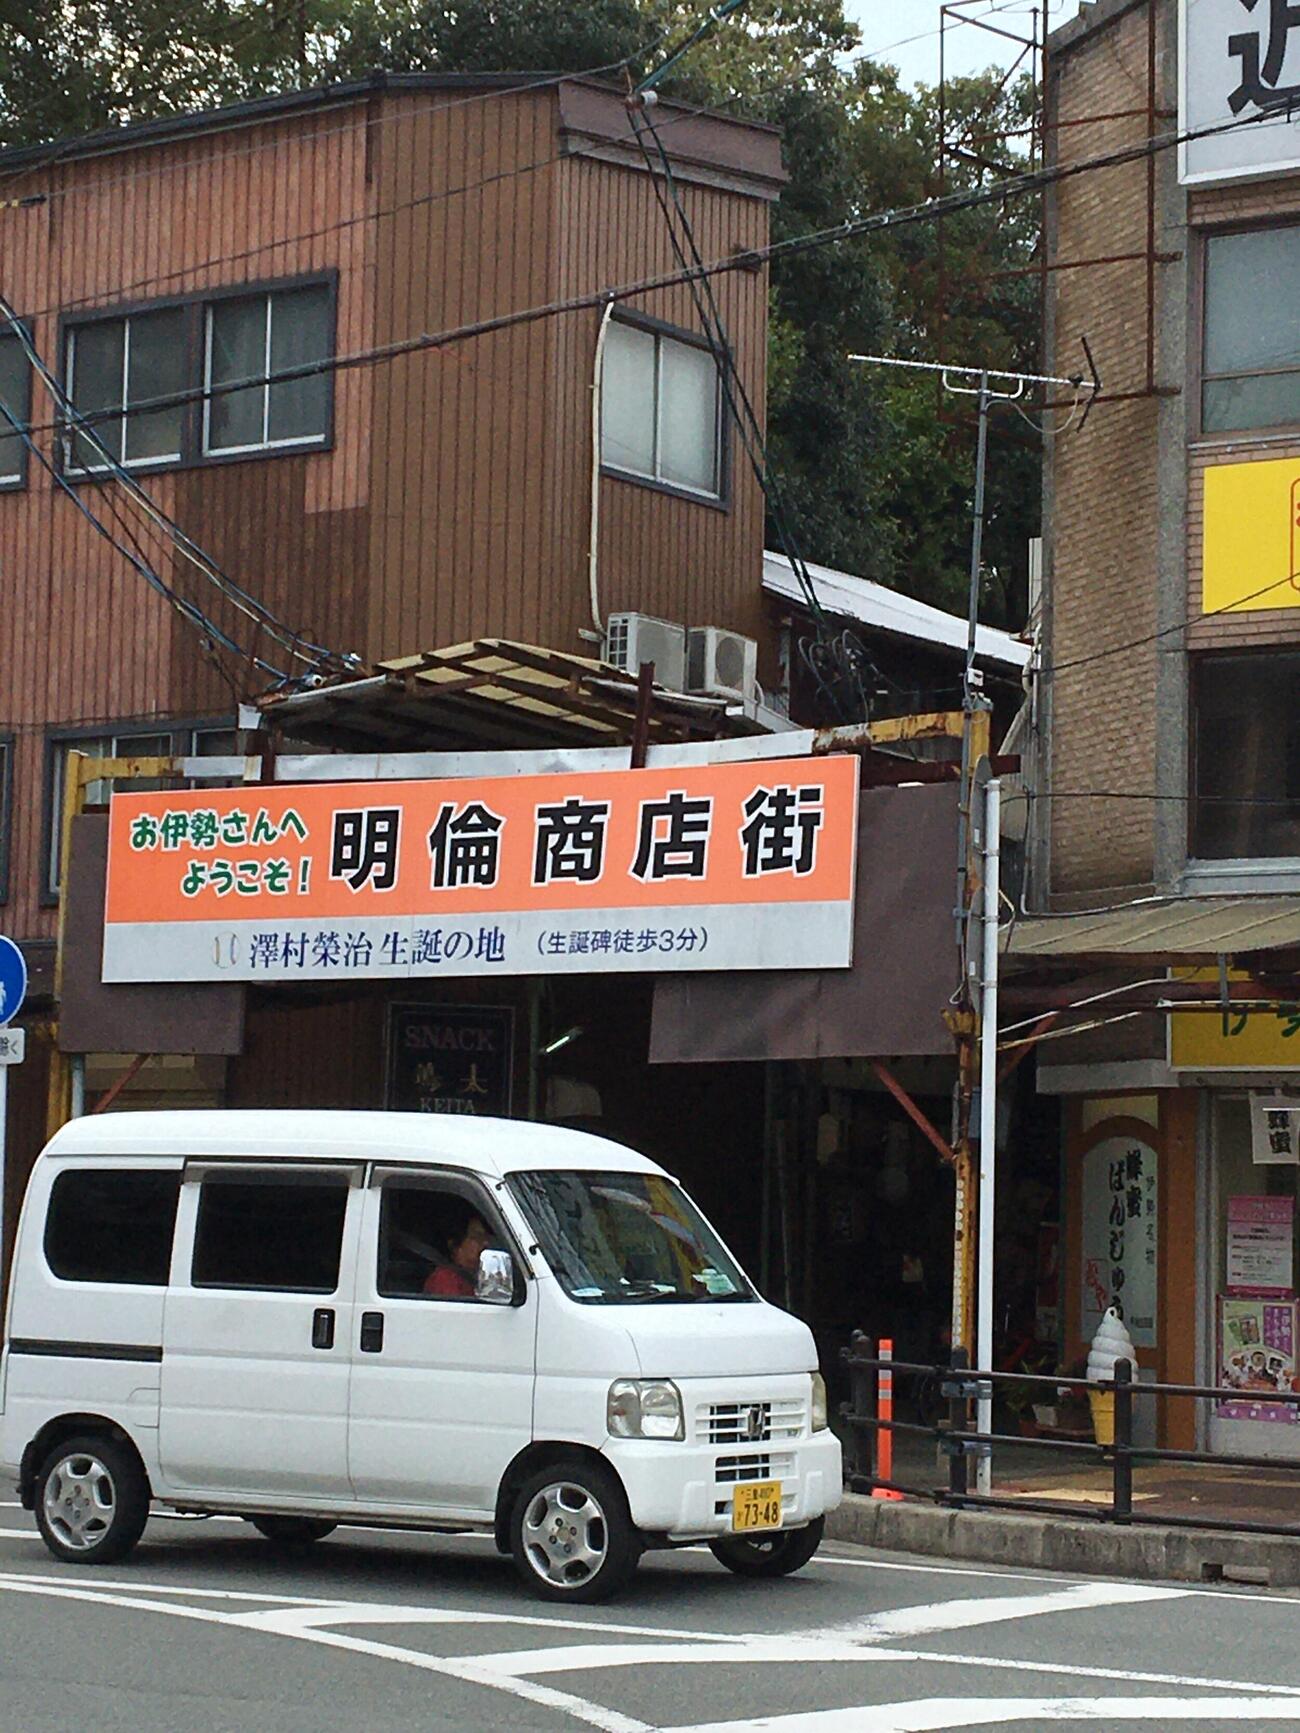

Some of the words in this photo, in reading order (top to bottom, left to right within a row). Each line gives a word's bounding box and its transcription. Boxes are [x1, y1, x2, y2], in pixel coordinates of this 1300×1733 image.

[130, 810, 307, 849] お伊勢さんへ
[331, 787, 823, 890] 明倫商店街
[181, 859, 312, 894] ようこそ!
[404, 1025, 494, 1050] SNACK
[420, 1098, 476, 1115] KEITA
[744, 1501, 779, 1526] 73-48
